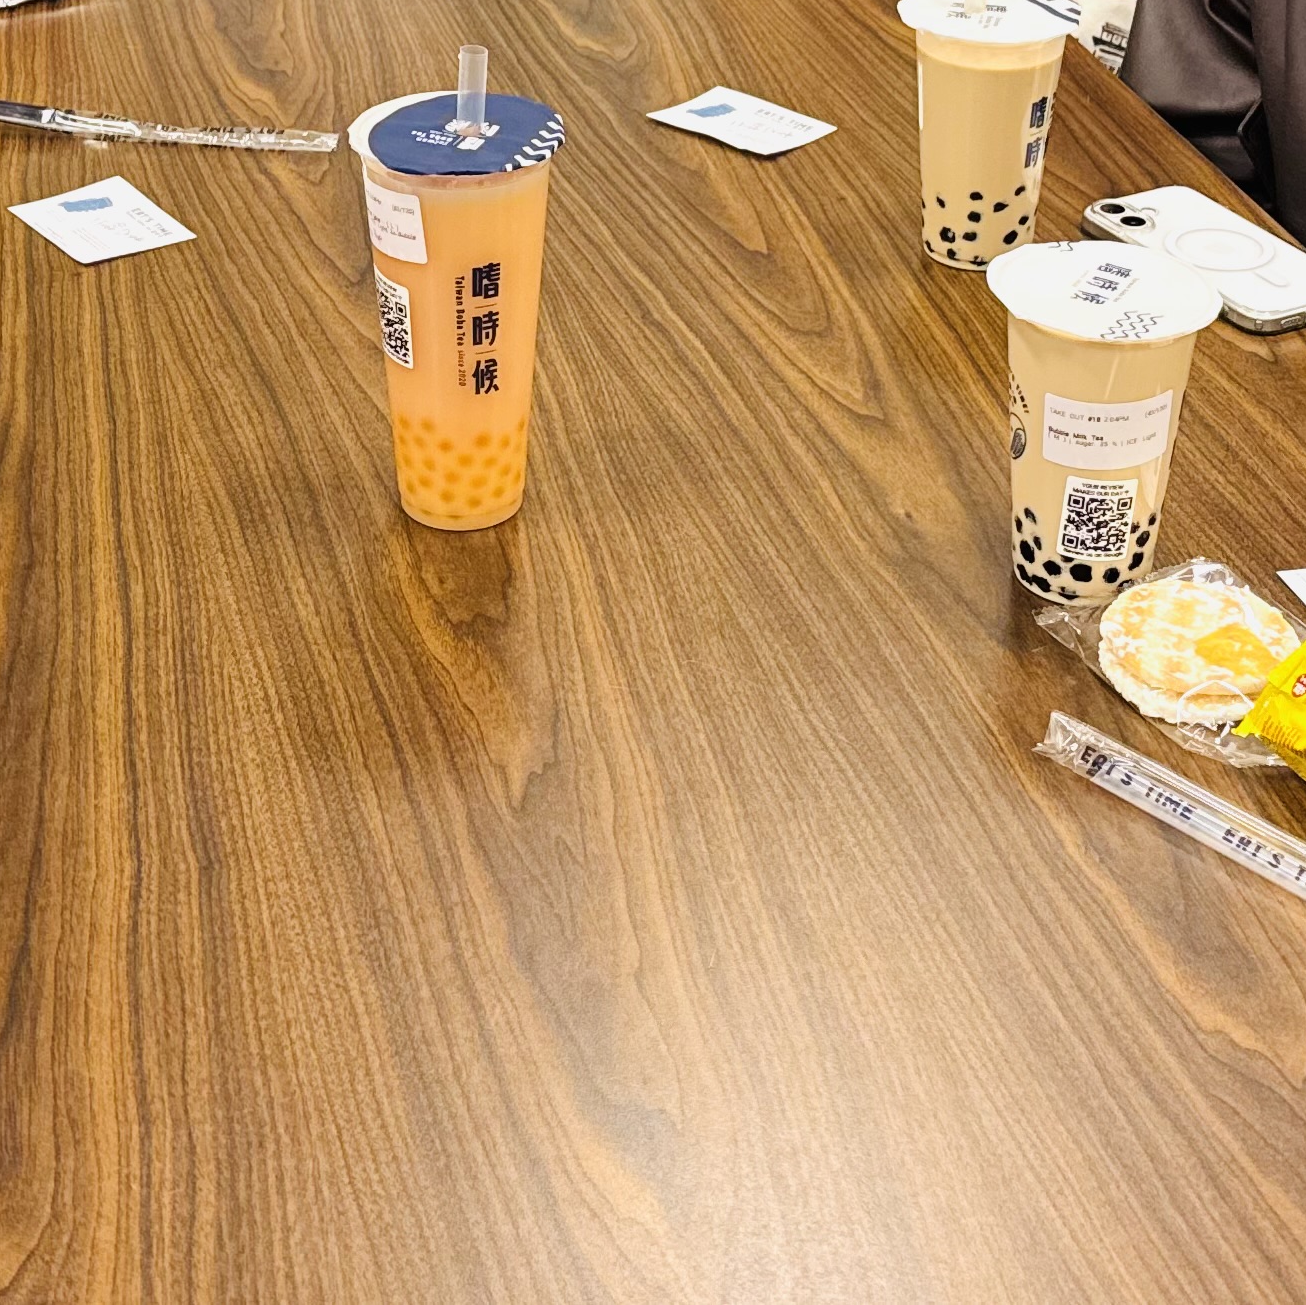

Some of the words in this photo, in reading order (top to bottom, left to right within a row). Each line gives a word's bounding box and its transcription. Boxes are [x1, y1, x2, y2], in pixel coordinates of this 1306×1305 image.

[454, 275, 465, 306] Taiwan
[456, 309, 466, 330] Boba
[456, 332, 466, 347] Tea
[457, 350, 465, 368] since
[1069, 413, 1085, 421] OUT
[1072, 432, 1088, 441] Milk
[1080, 744, 1135, 786] EAT'S
[1144, 784, 1197, 821] TIME
[1221, 826, 1286, 869] EAT'S
